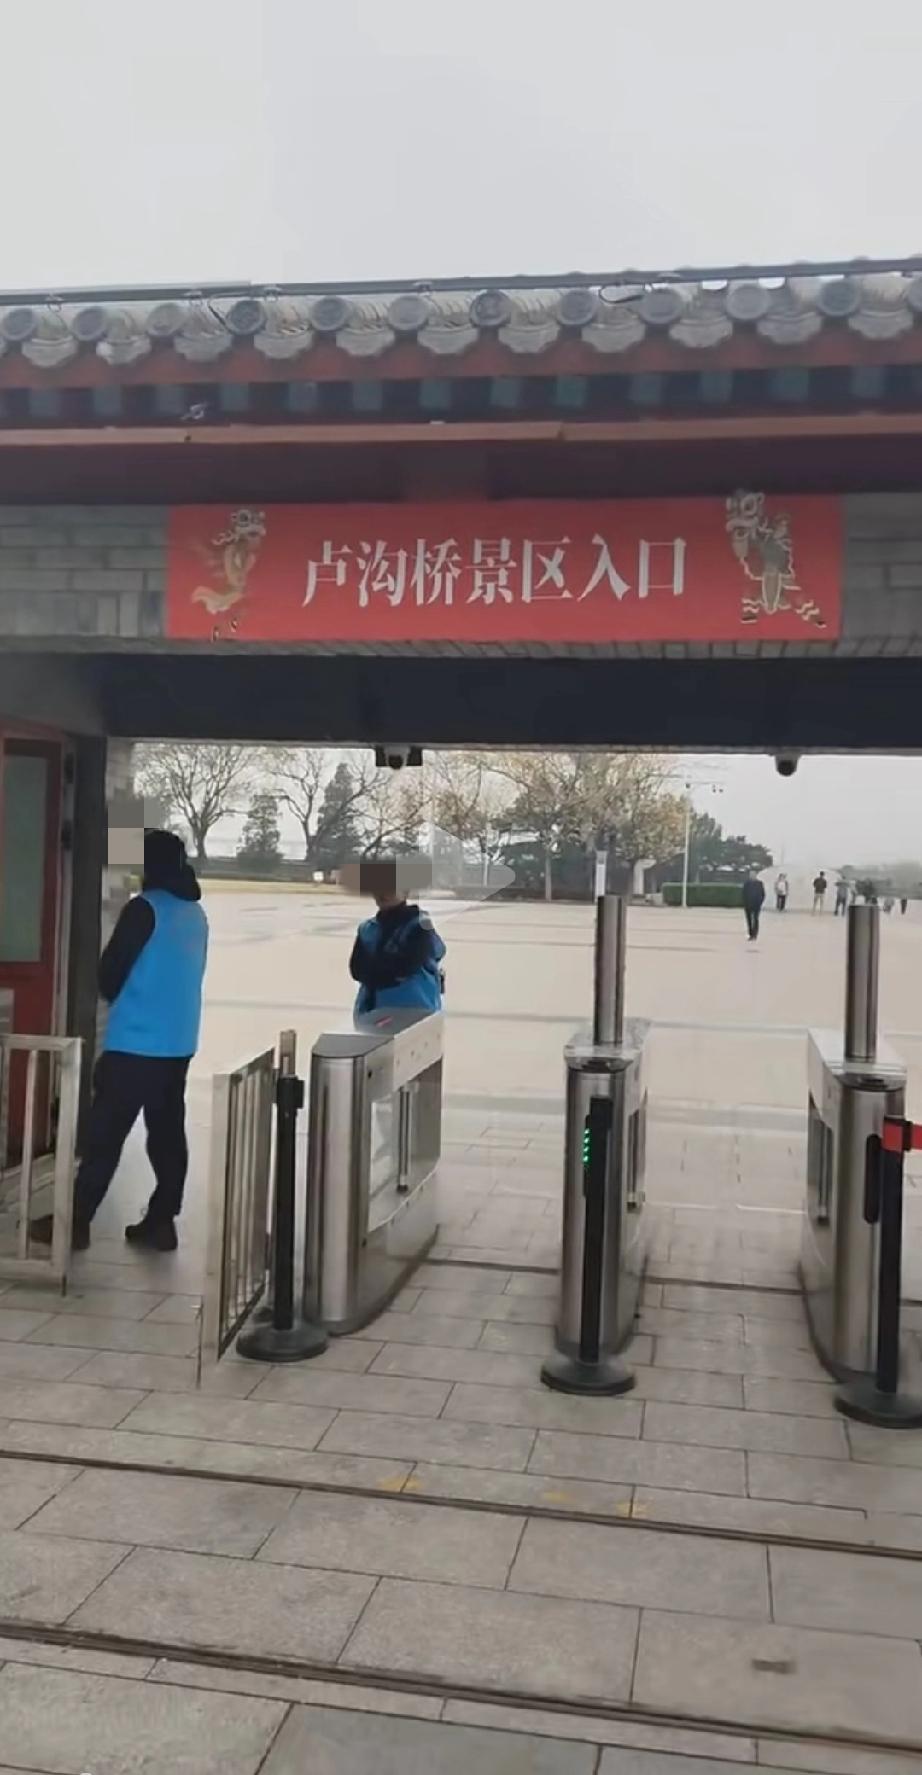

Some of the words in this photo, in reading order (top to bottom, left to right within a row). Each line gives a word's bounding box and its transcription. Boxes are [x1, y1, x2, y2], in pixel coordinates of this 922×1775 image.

[302, 533, 687, 607] 卢沟桥景区入口
